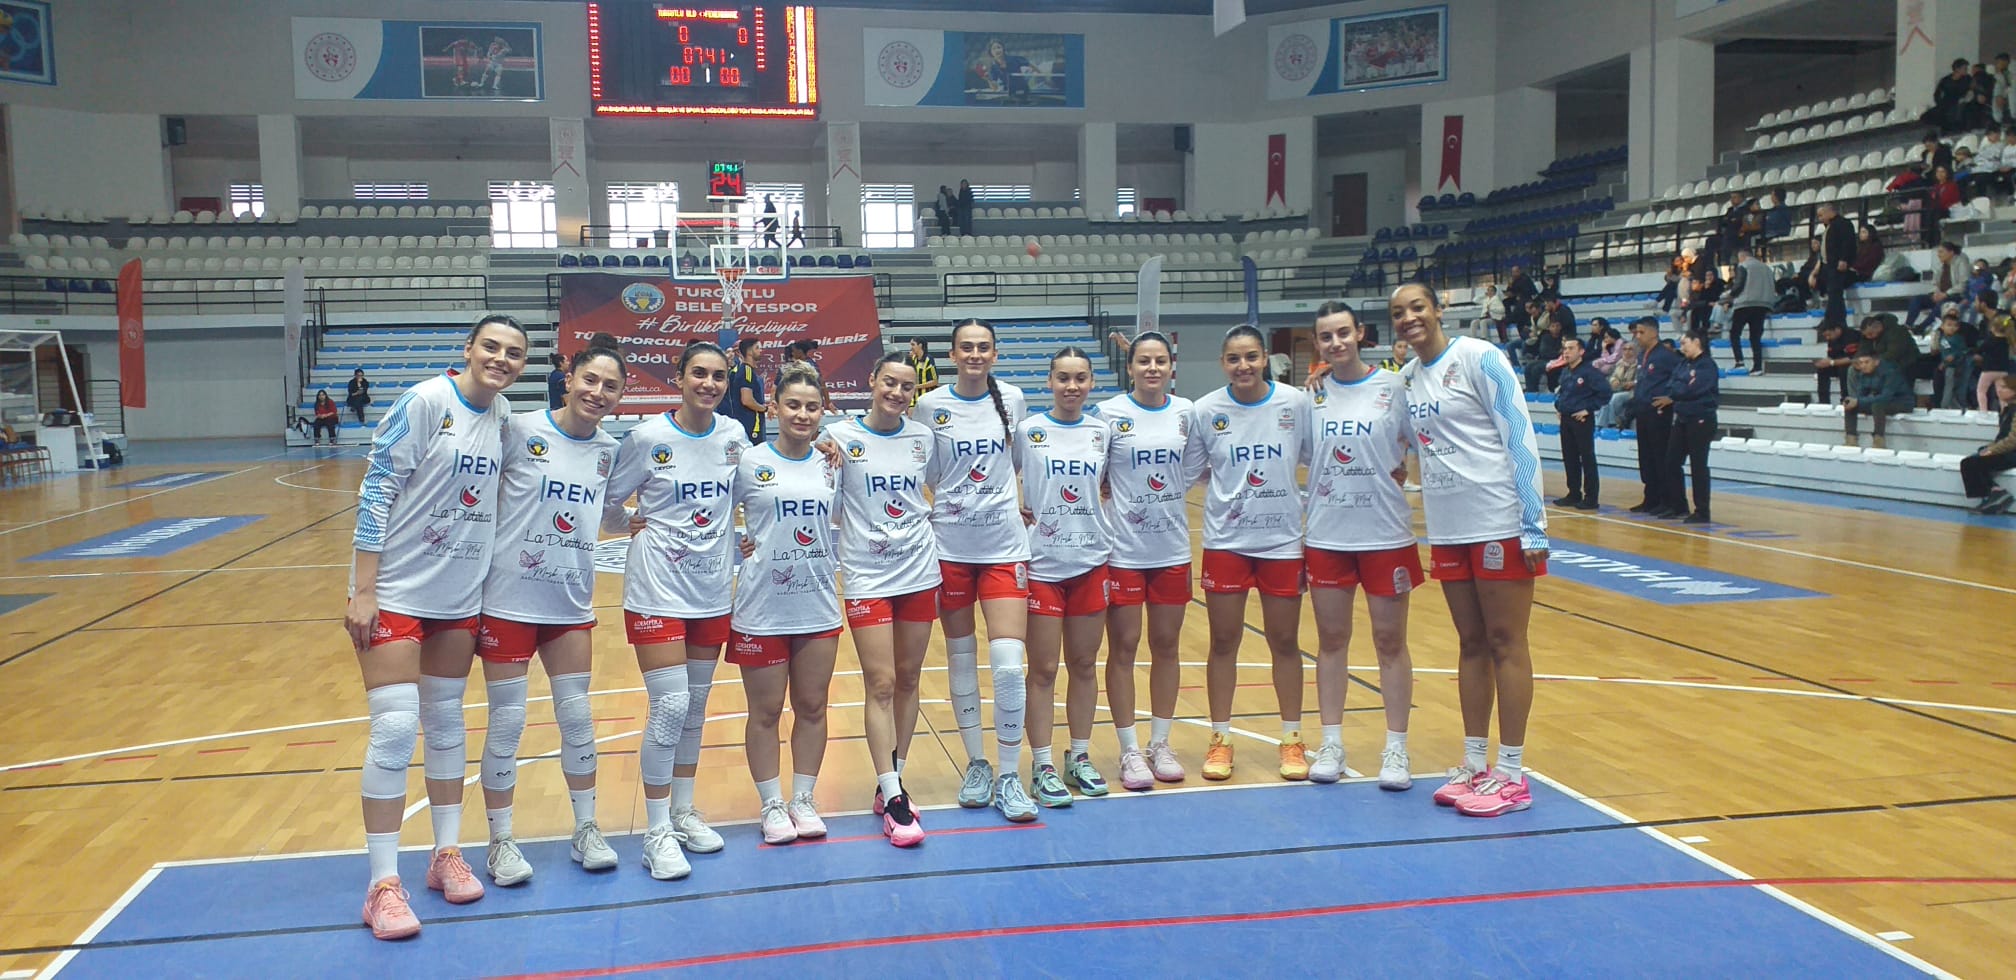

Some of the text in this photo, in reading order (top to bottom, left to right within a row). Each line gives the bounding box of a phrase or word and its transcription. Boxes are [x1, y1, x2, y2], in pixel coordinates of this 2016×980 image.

[679, 25, 748, 44] 0 0
[671, 65, 690, 84] 00
[720, 66, 740, 84] 00
[712, 172, 742, 196] 24
[674, 286, 776, 299] TURGTLU
[1128, 492, 1145, 504] La
[430, 503, 450, 519] La
[523, 529, 545, 544] La
[666, 527, 688, 539] La
[772, 549, 790, 561] La
[1549, 549, 1694, 582] HALKB
